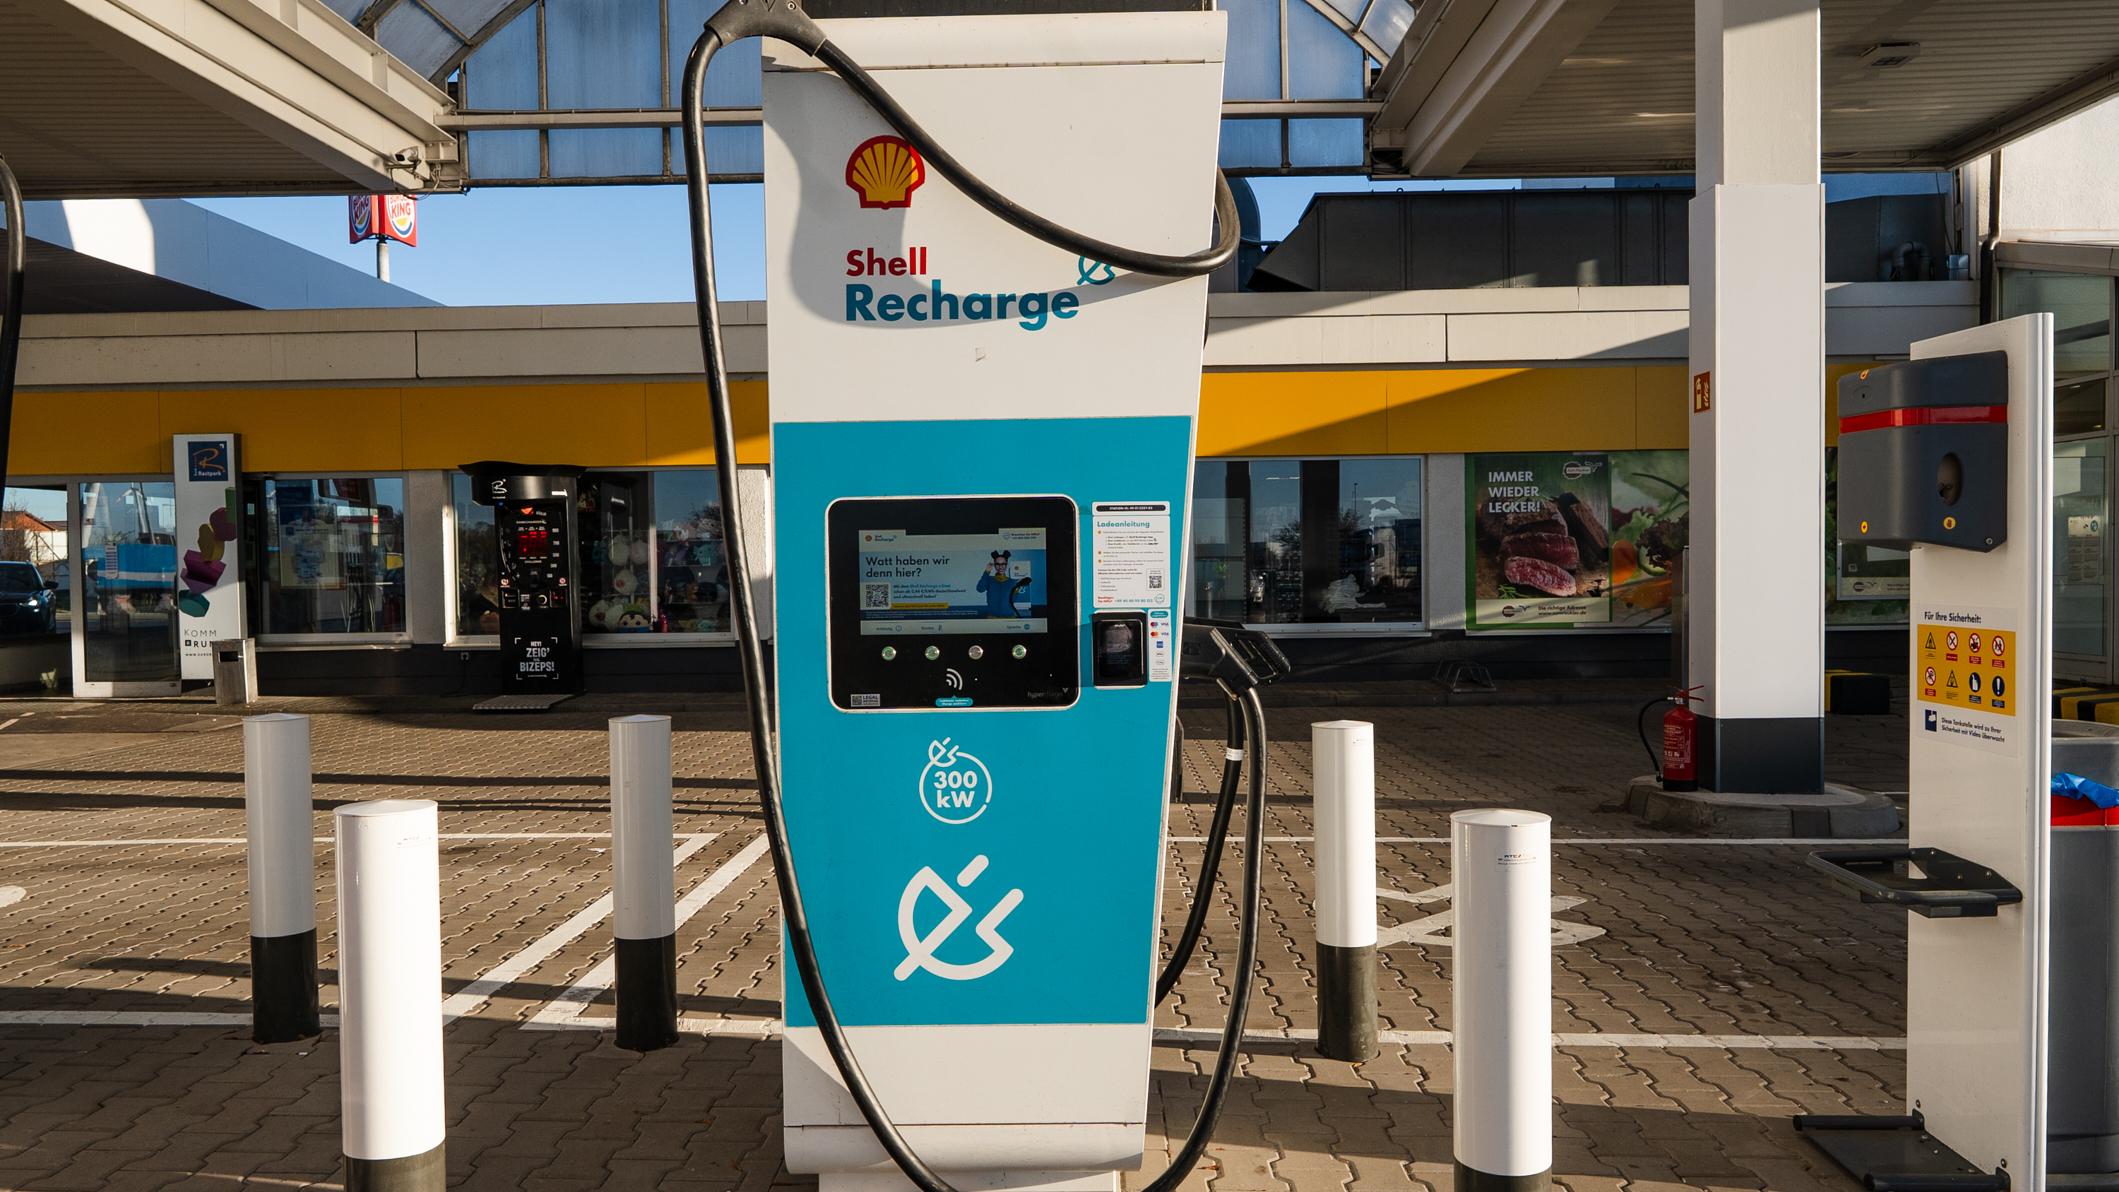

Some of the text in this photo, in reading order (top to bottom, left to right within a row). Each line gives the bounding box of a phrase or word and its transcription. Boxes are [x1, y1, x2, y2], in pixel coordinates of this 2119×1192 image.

[391, 202, 411, 218] KING
[846, 247, 927, 276] Shell
[846, 279, 1080, 331] Recharge
[1488, 471, 1533, 482] IMMER
[1488, 486, 1540, 497] WIEDER
[1488, 501, 1541, 513] LECKER!
[1097, 520, 1150, 528] Ladeanleitung
[865, 555, 950, 566] Watt haben wir
[865, 567, 922, 578] denn hier?
[1925, 611, 1982, 624] Für Ihre Sicherheit:
[184, 629, 217, 637] KOMM
[526, 647, 550, 658] ZEIG'
[519, 661, 555, 672] BIZEPS!
[1942, 724, 1961, 733] Sicherheit
[1969, 730, 1981, 738] Video
[1982, 732, 2005, 743] überwacht
[934, 770, 977, 789] 300
[936, 790, 975, 808] kW
